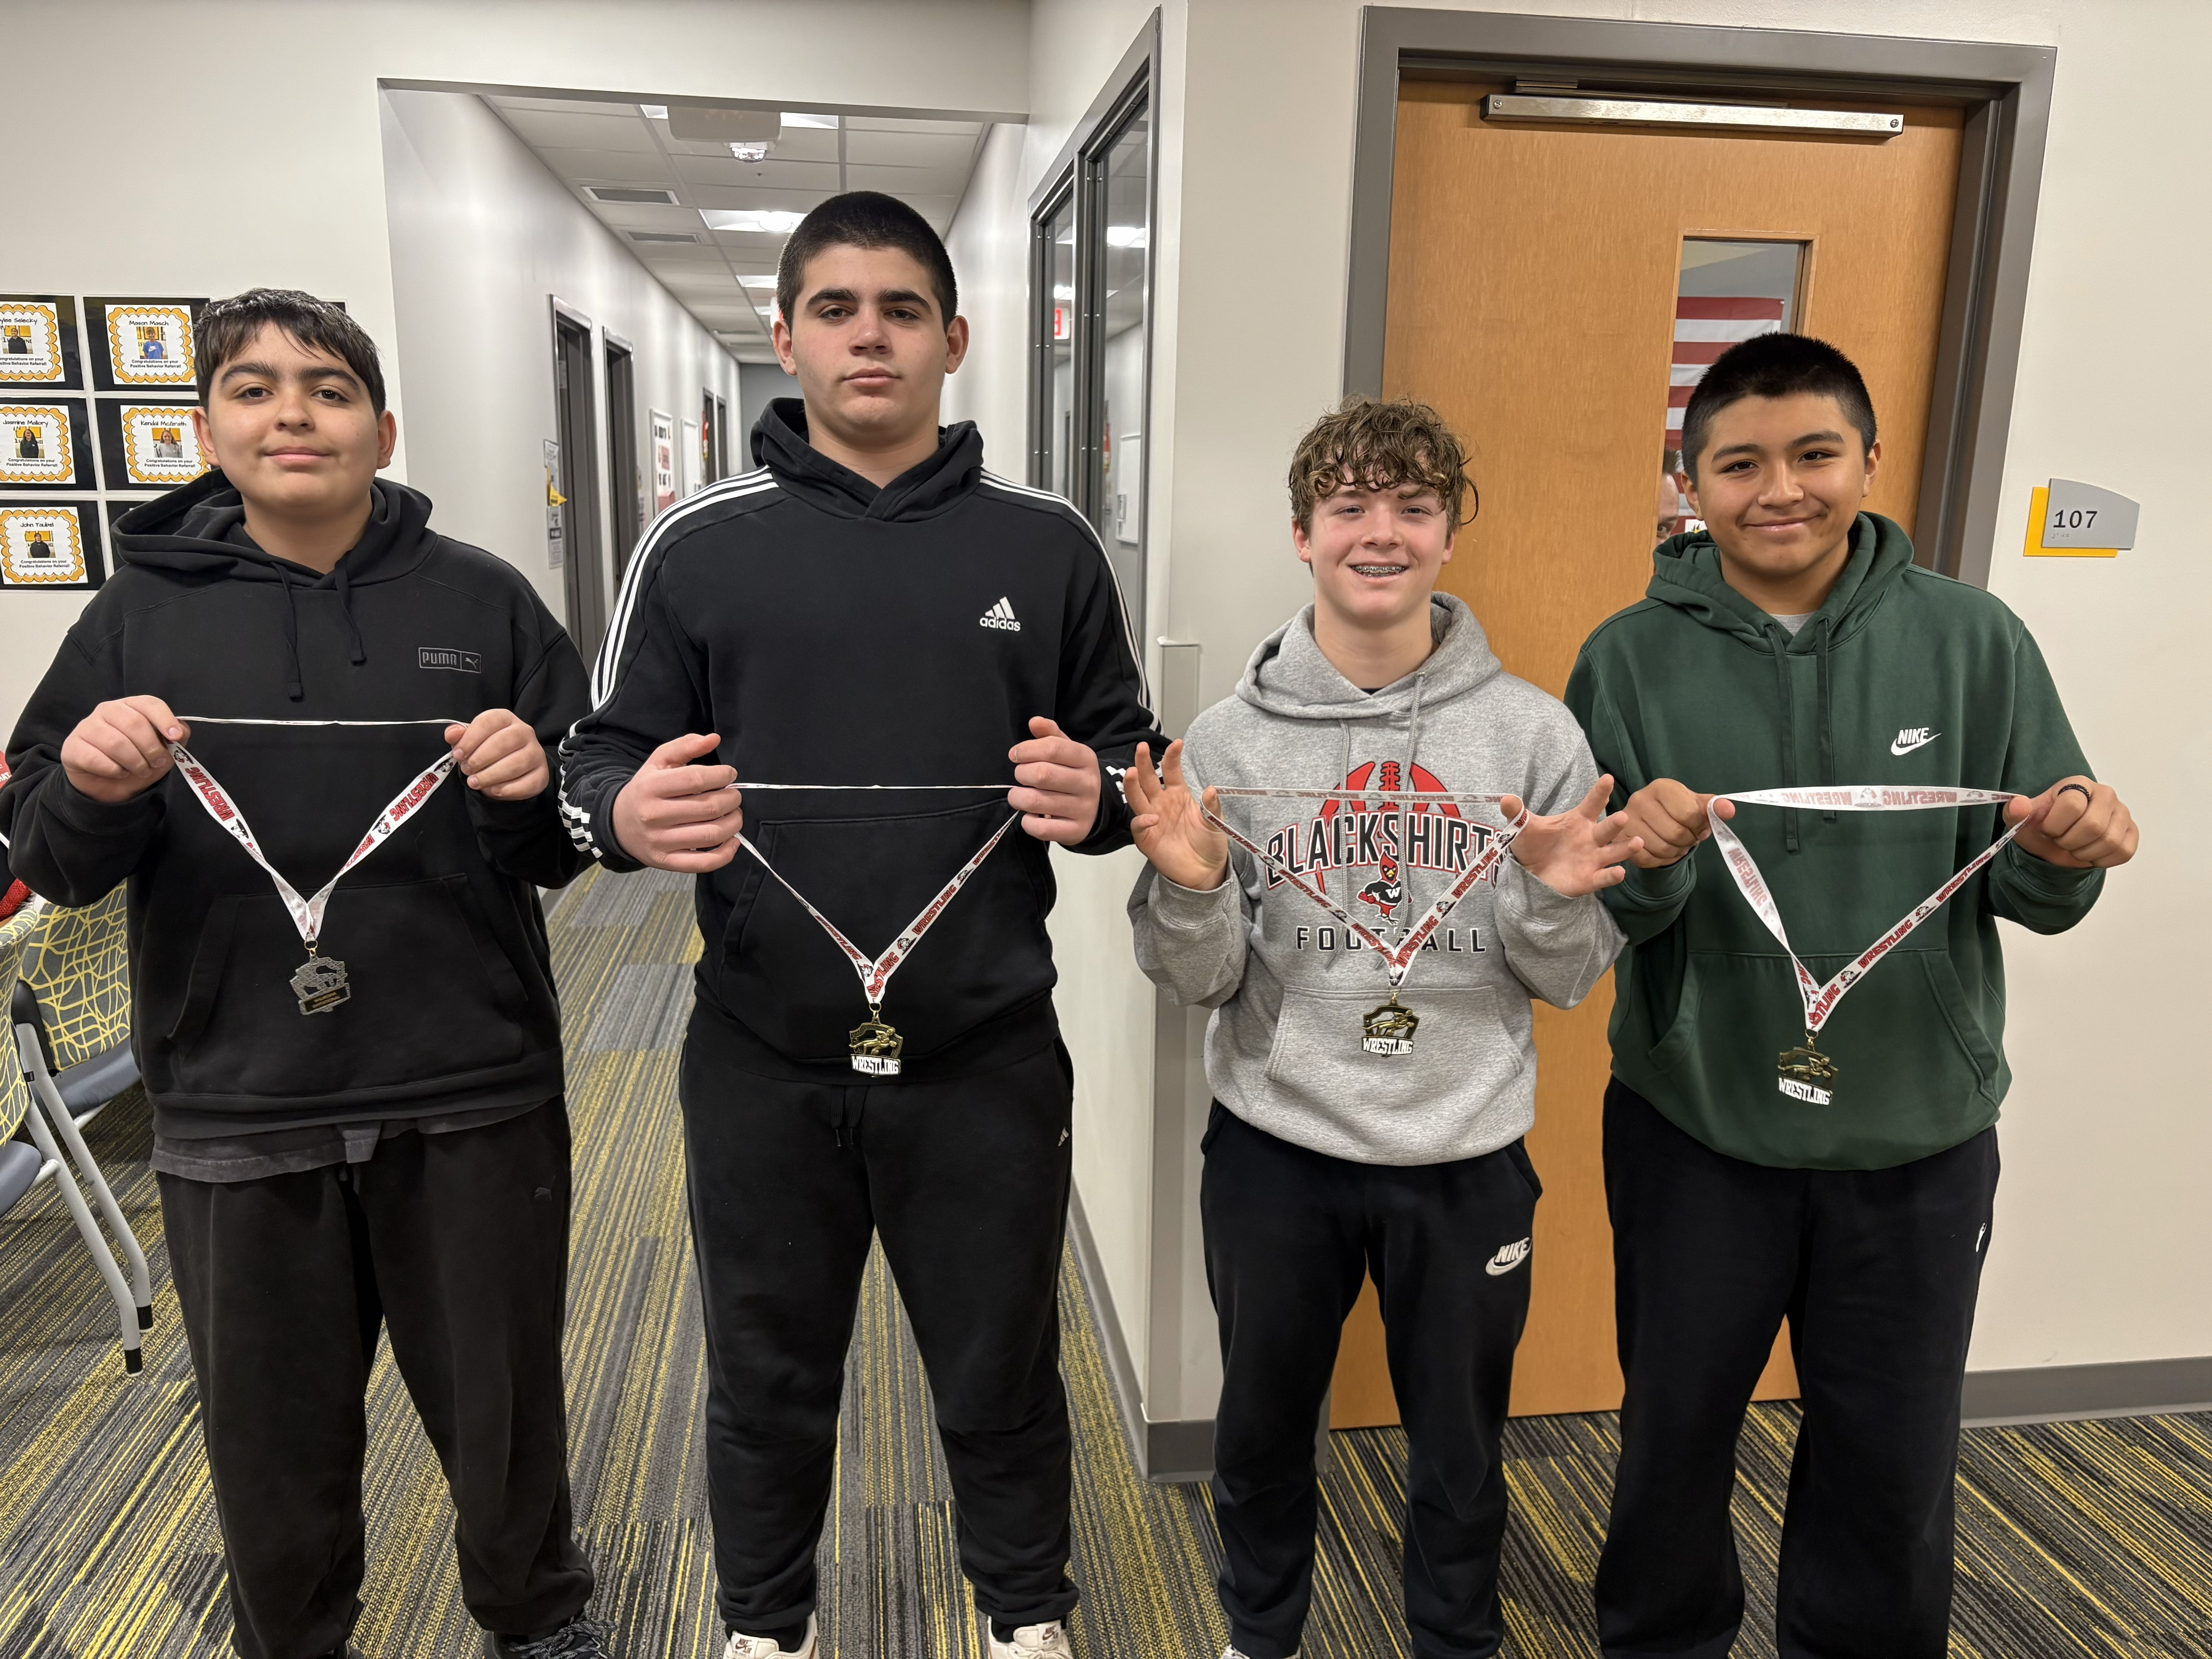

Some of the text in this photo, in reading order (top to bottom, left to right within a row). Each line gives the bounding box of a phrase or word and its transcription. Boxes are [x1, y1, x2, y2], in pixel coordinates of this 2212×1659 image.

[2053, 510, 2097, 528] 107
[979, 617, 1021, 632] adidas
[422, 652, 457, 666] PUMA
[1898, 727, 1929, 744] NIKE
[185, 767, 235, 821] WRESTLING
[389, 772, 439, 821] WRESTLING
[1207, 815, 1260, 854] WRESTLING
[1278, 869, 1332, 908] WRESTLING
[1385, 887, 1401, 898] W
[1451, 847, 1498, 899] WRESTLING
[1936, 852, 1991, 902] WRESTLING
[912, 884, 957, 935] WRESTLING
[1351, 923, 1396, 968] WRESTLING
[1395, 915, 1439, 968] WRESTLING
[1858, 919, 1913, 969] WRESTLING
[852, 1056, 899, 1074] WRESTLING
[1363, 1037, 1413, 1054] WRESTLING
[1778, 1077, 1831, 1105] WRESTLING
[1495, 1237, 1529, 1262] NIKE
